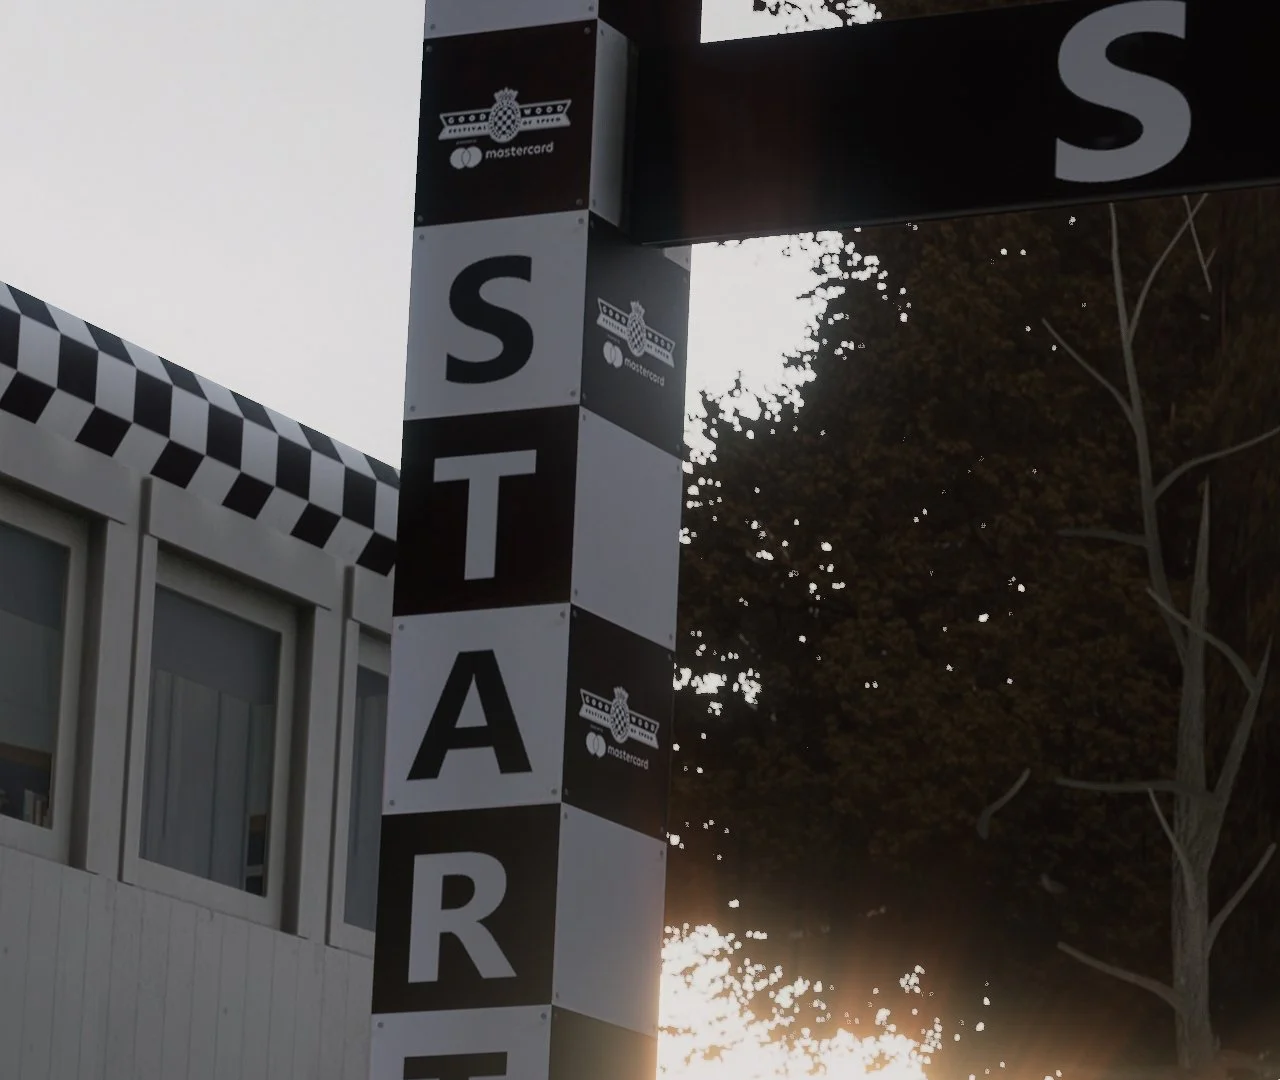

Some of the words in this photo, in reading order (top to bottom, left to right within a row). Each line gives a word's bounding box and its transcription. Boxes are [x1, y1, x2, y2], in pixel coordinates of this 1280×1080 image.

[485, 141, 554, 160] mastercard
[624, 357, 665, 387] mastercard
[607, 744, 649, 770] mastercard
